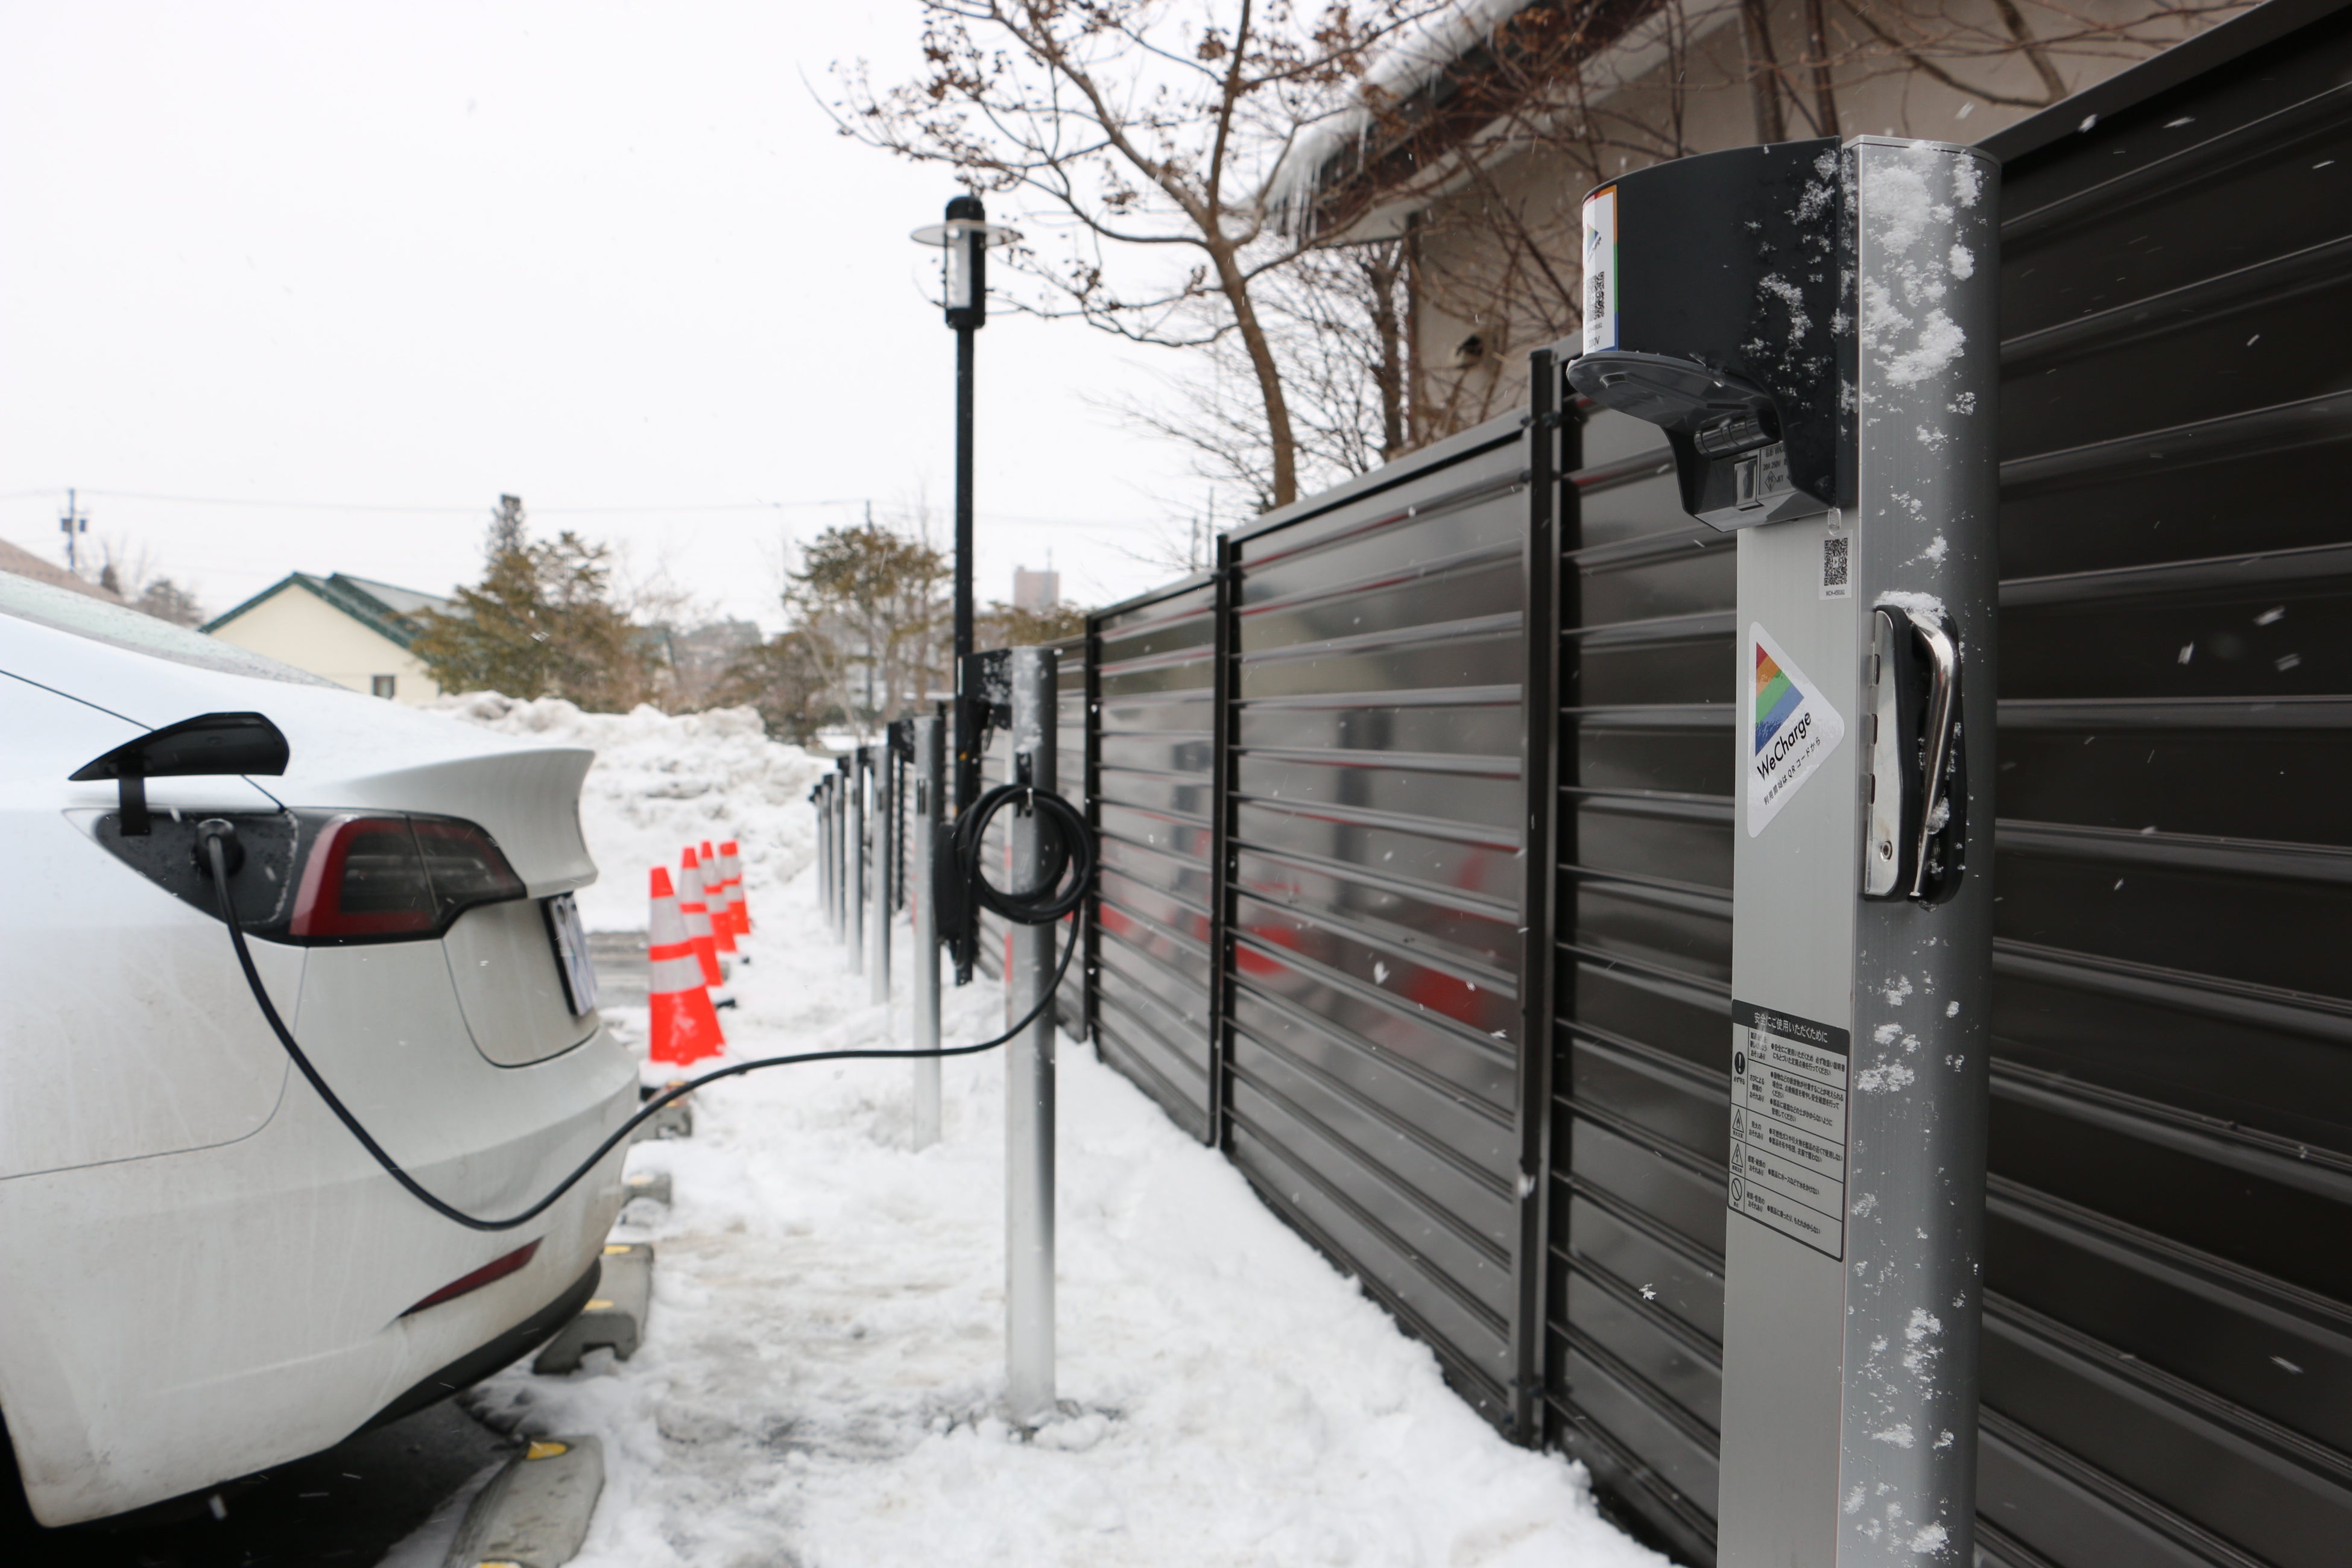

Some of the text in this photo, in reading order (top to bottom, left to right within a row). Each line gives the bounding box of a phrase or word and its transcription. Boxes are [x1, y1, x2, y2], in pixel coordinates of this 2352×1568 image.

[1757, 712, 1811, 781] WeCharge
[1754, 1012, 1827, 1043] 安全にご使用いただくために
